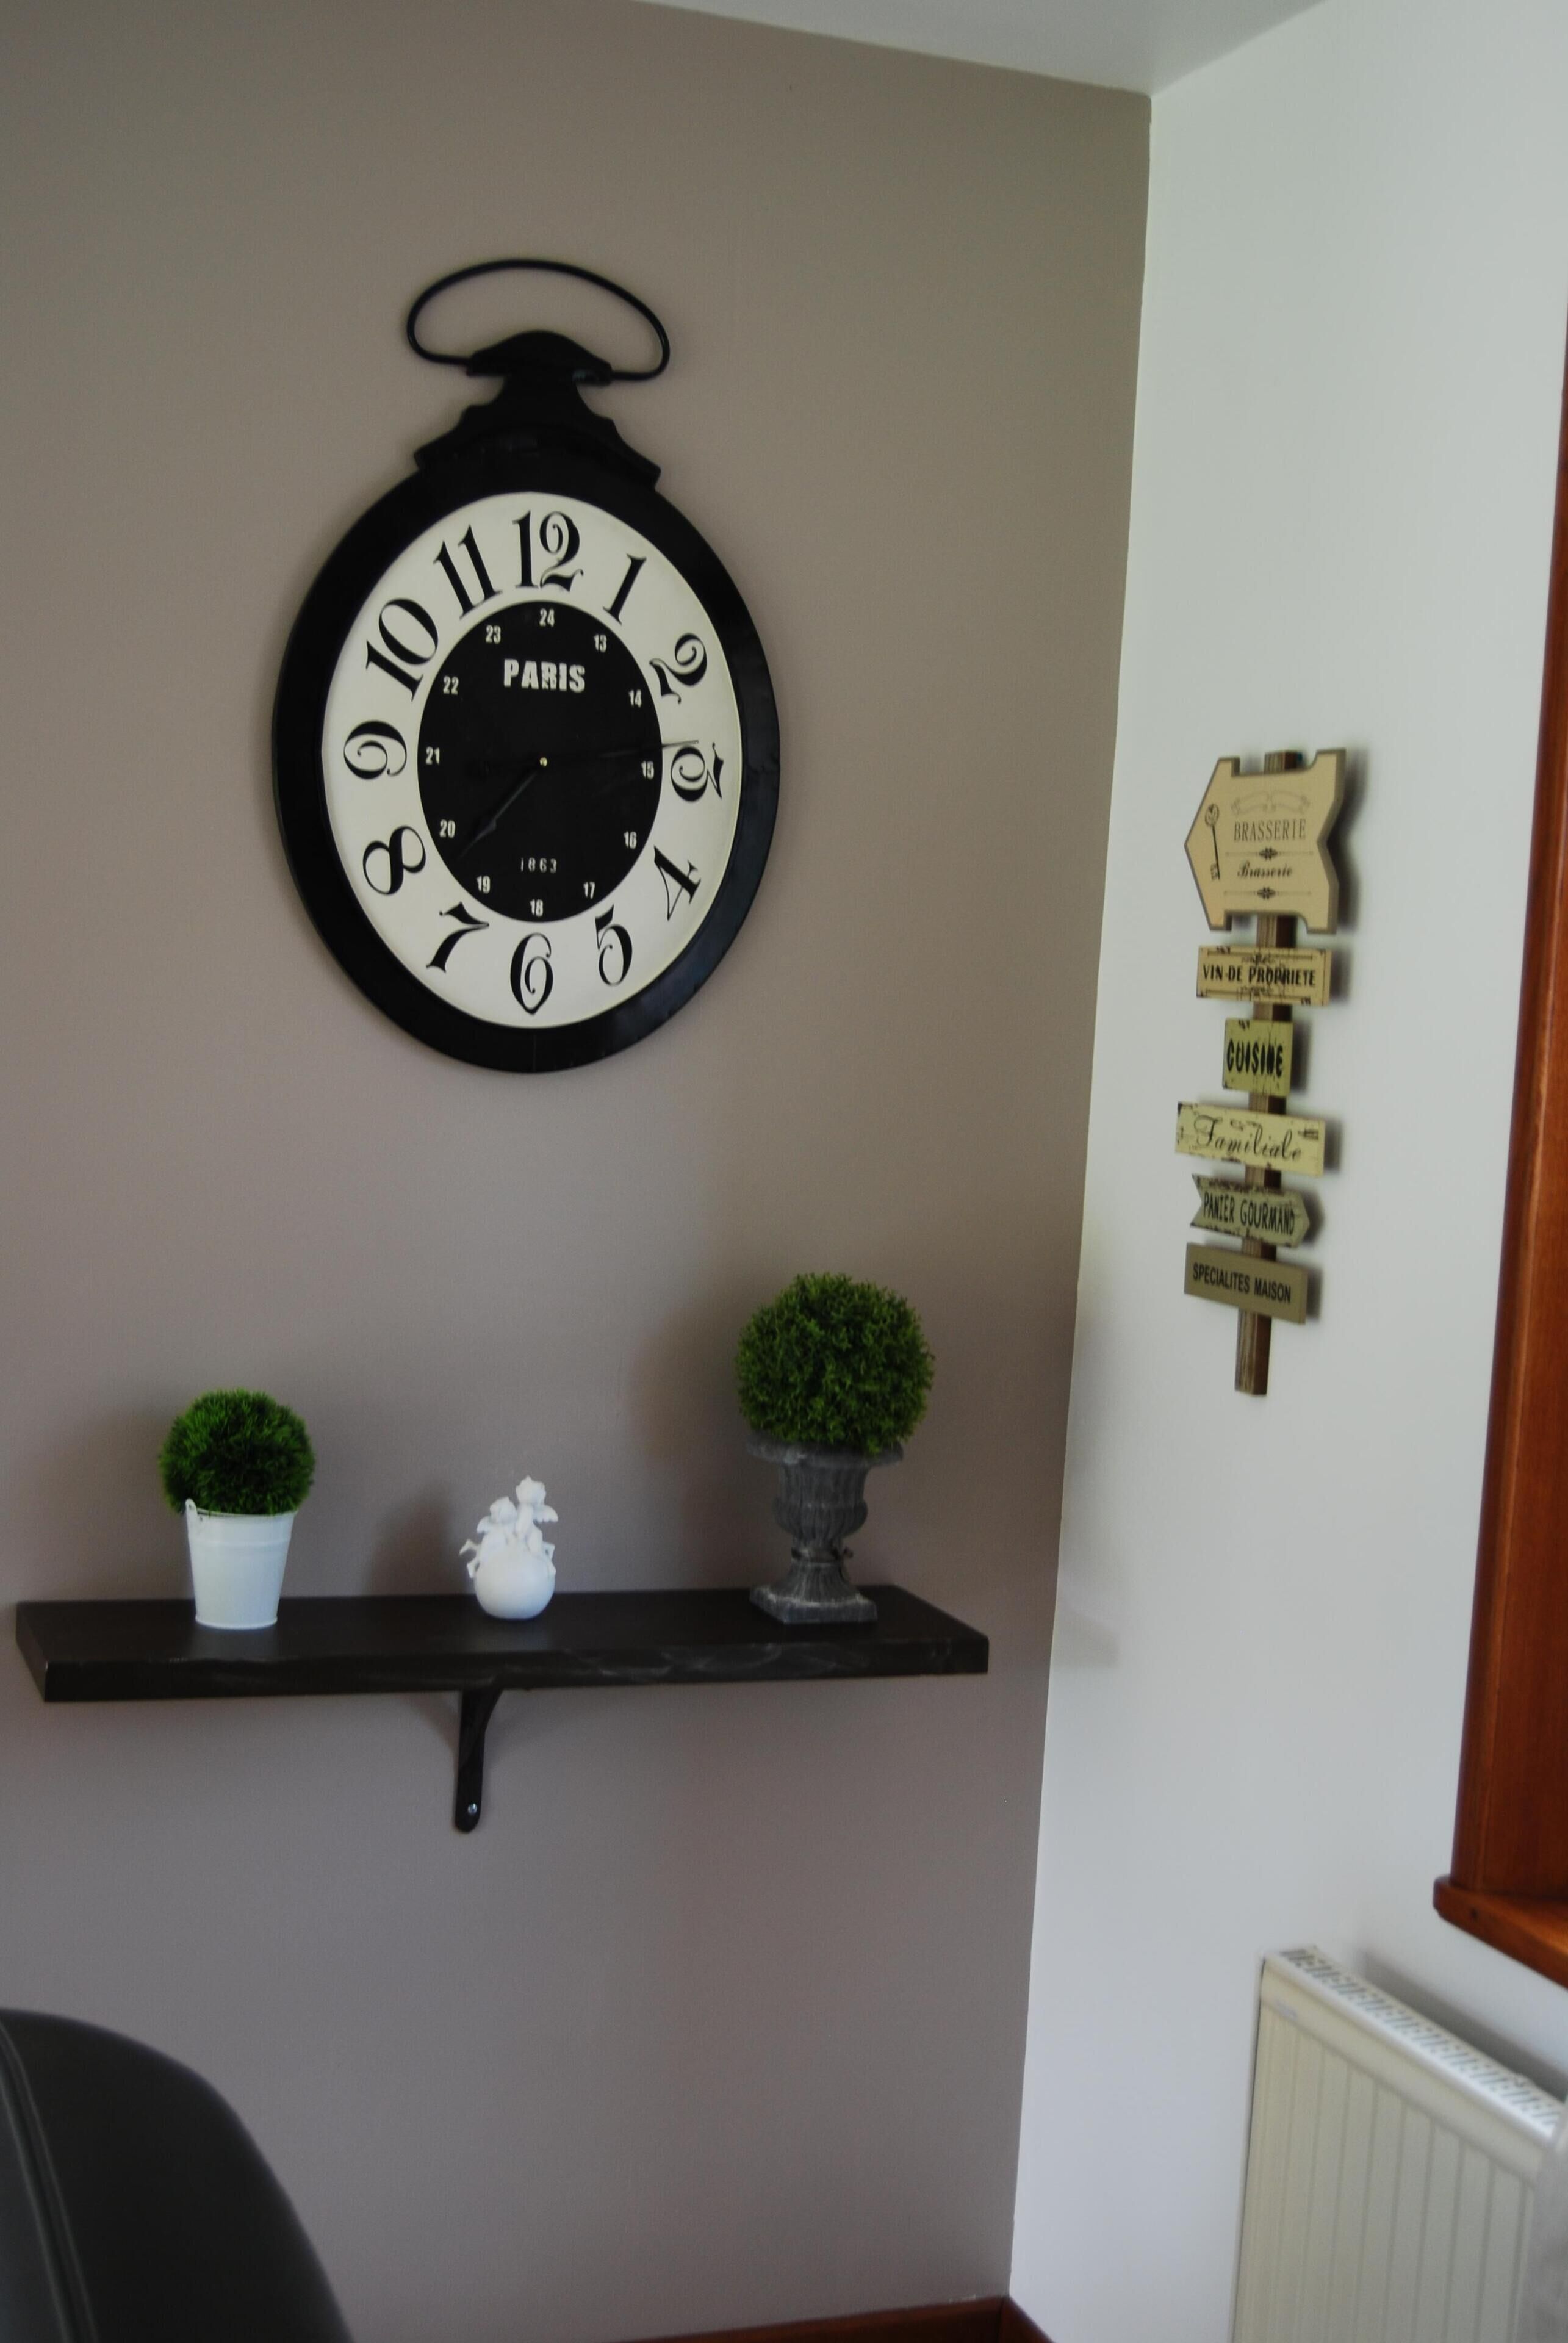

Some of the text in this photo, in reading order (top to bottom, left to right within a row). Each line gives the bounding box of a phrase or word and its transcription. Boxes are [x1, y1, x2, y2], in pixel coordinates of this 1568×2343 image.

[512, 510, 584, 592] 12
[433, 525, 501, 619] 11
[603, 553, 647, 625] 1
[485, 624, 502, 644] 23
[539, 608, 555, 627] 24
[365, 597, 439, 702] 10
[594, 634, 607, 653] 13
[442, 675, 459, 695] 22
[503, 658, 586, 693] PARIS
[649, 632, 708, 704] 2
[628, 689, 642, 708] 14
[343, 719, 408, 780] 9
[425, 746, 440, 765] 21
[641, 761, 655, 779] 15
[670, 742, 724, 803] 3
[439, 819, 456, 838] 20
[624, 831, 637, 849] 16
[1234, 818, 1306, 841] BRASSERIE
[362, 825, 426, 896] 8
[520, 857, 557, 873] 1863
[1237, 860, 1292, 878] Brasserie
[476, 875, 491, 894] 19
[583, 881, 595, 899] 17
[653, 845, 702, 921] 4
[530, 899, 544, 917] 18
[425, 901, 490, 973] 7
[594, 904, 633, 986] 5
[509, 933, 554, 1016] 6
[1203, 964, 1316, 987] VIN DE PROPRIETE
[1226, 1038, 1283, 1078] CUISINE
[1193, 1114, 1303, 1161] Familiale
[1203, 1192, 1296, 1236] PANIER GOURMAND
[1193, 1262, 1292, 1303] SPECIALITES MAISON
